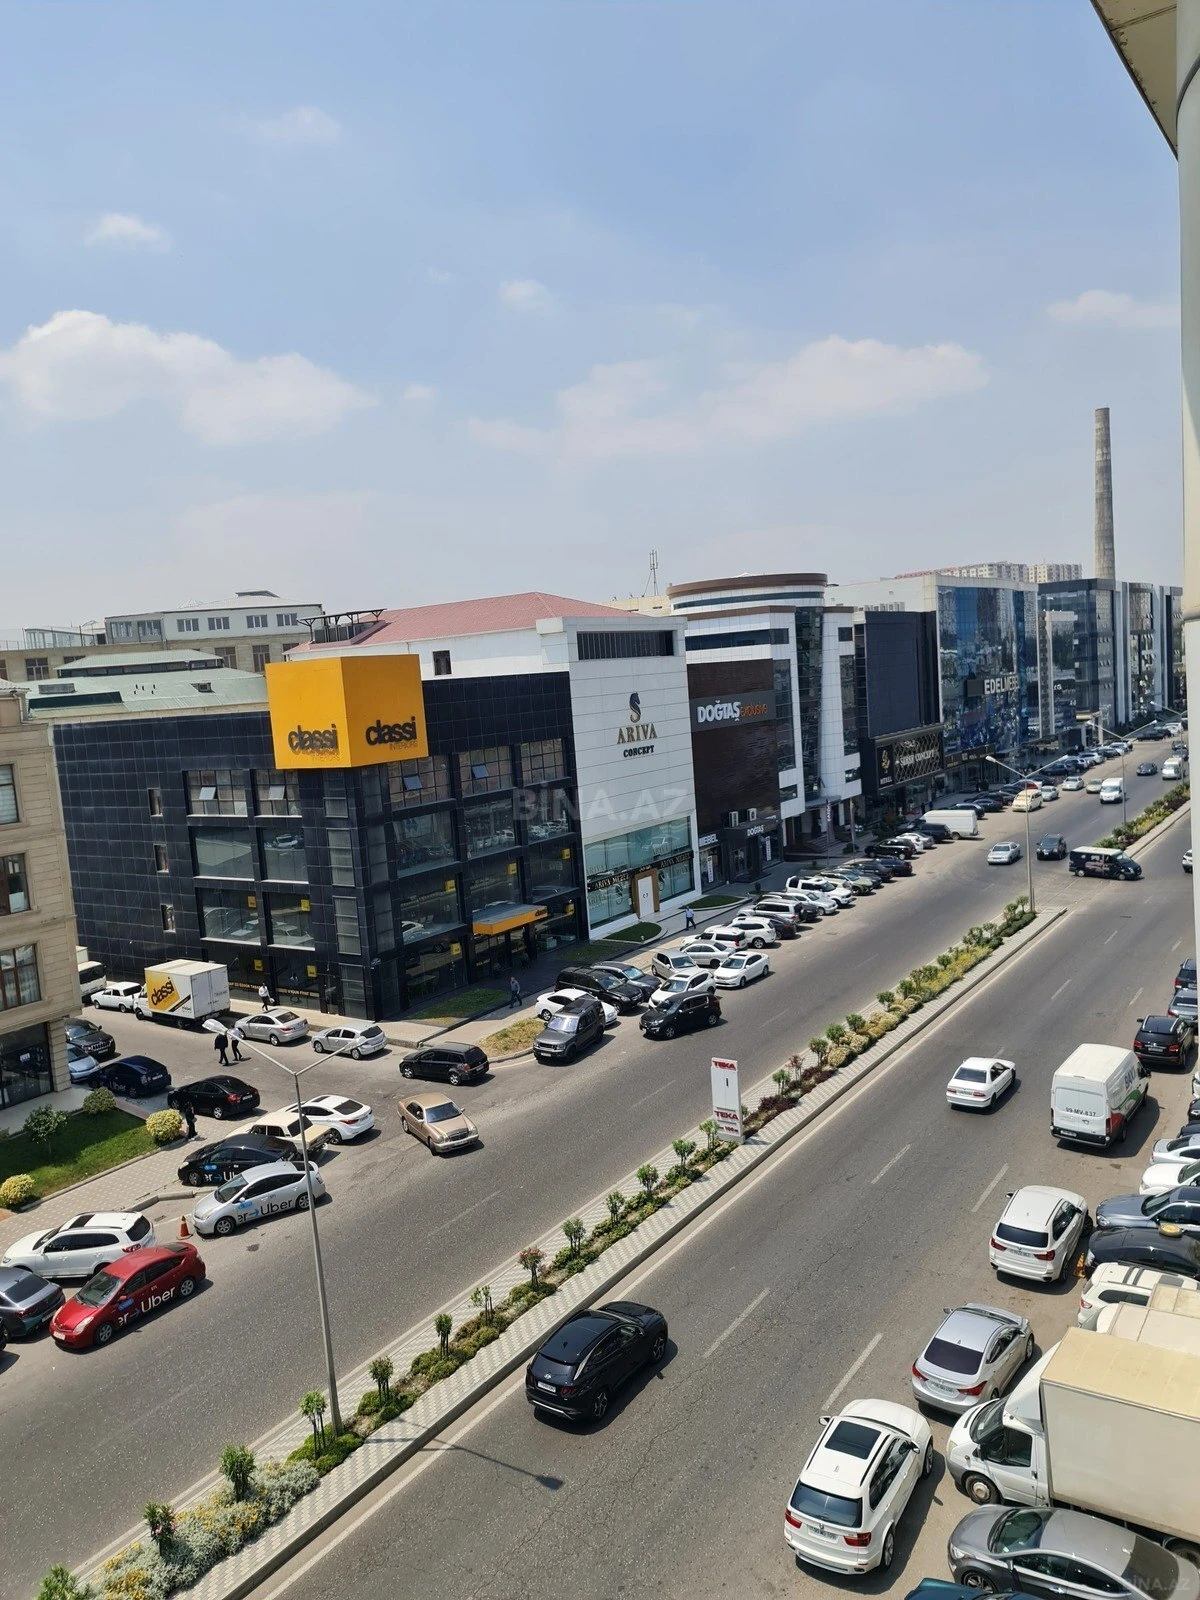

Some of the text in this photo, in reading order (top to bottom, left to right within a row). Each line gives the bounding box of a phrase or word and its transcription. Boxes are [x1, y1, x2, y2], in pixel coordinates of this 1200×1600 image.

[697, 700, 742, 723] DOĞTAŞ
[288, 723, 338, 753] classi
[365, 716, 417, 746] classi
[617, 723, 658, 744] ARIVA
[623, 745, 655, 758] CONCEPT
[151, 976, 175, 1006] classi
[713, 1061, 737, 1071] TEKA
[714, 1110, 739, 1121] TEKA
[260, 1199, 293, 1216] Uber
[141, 1286, 176, 1313] Uber
